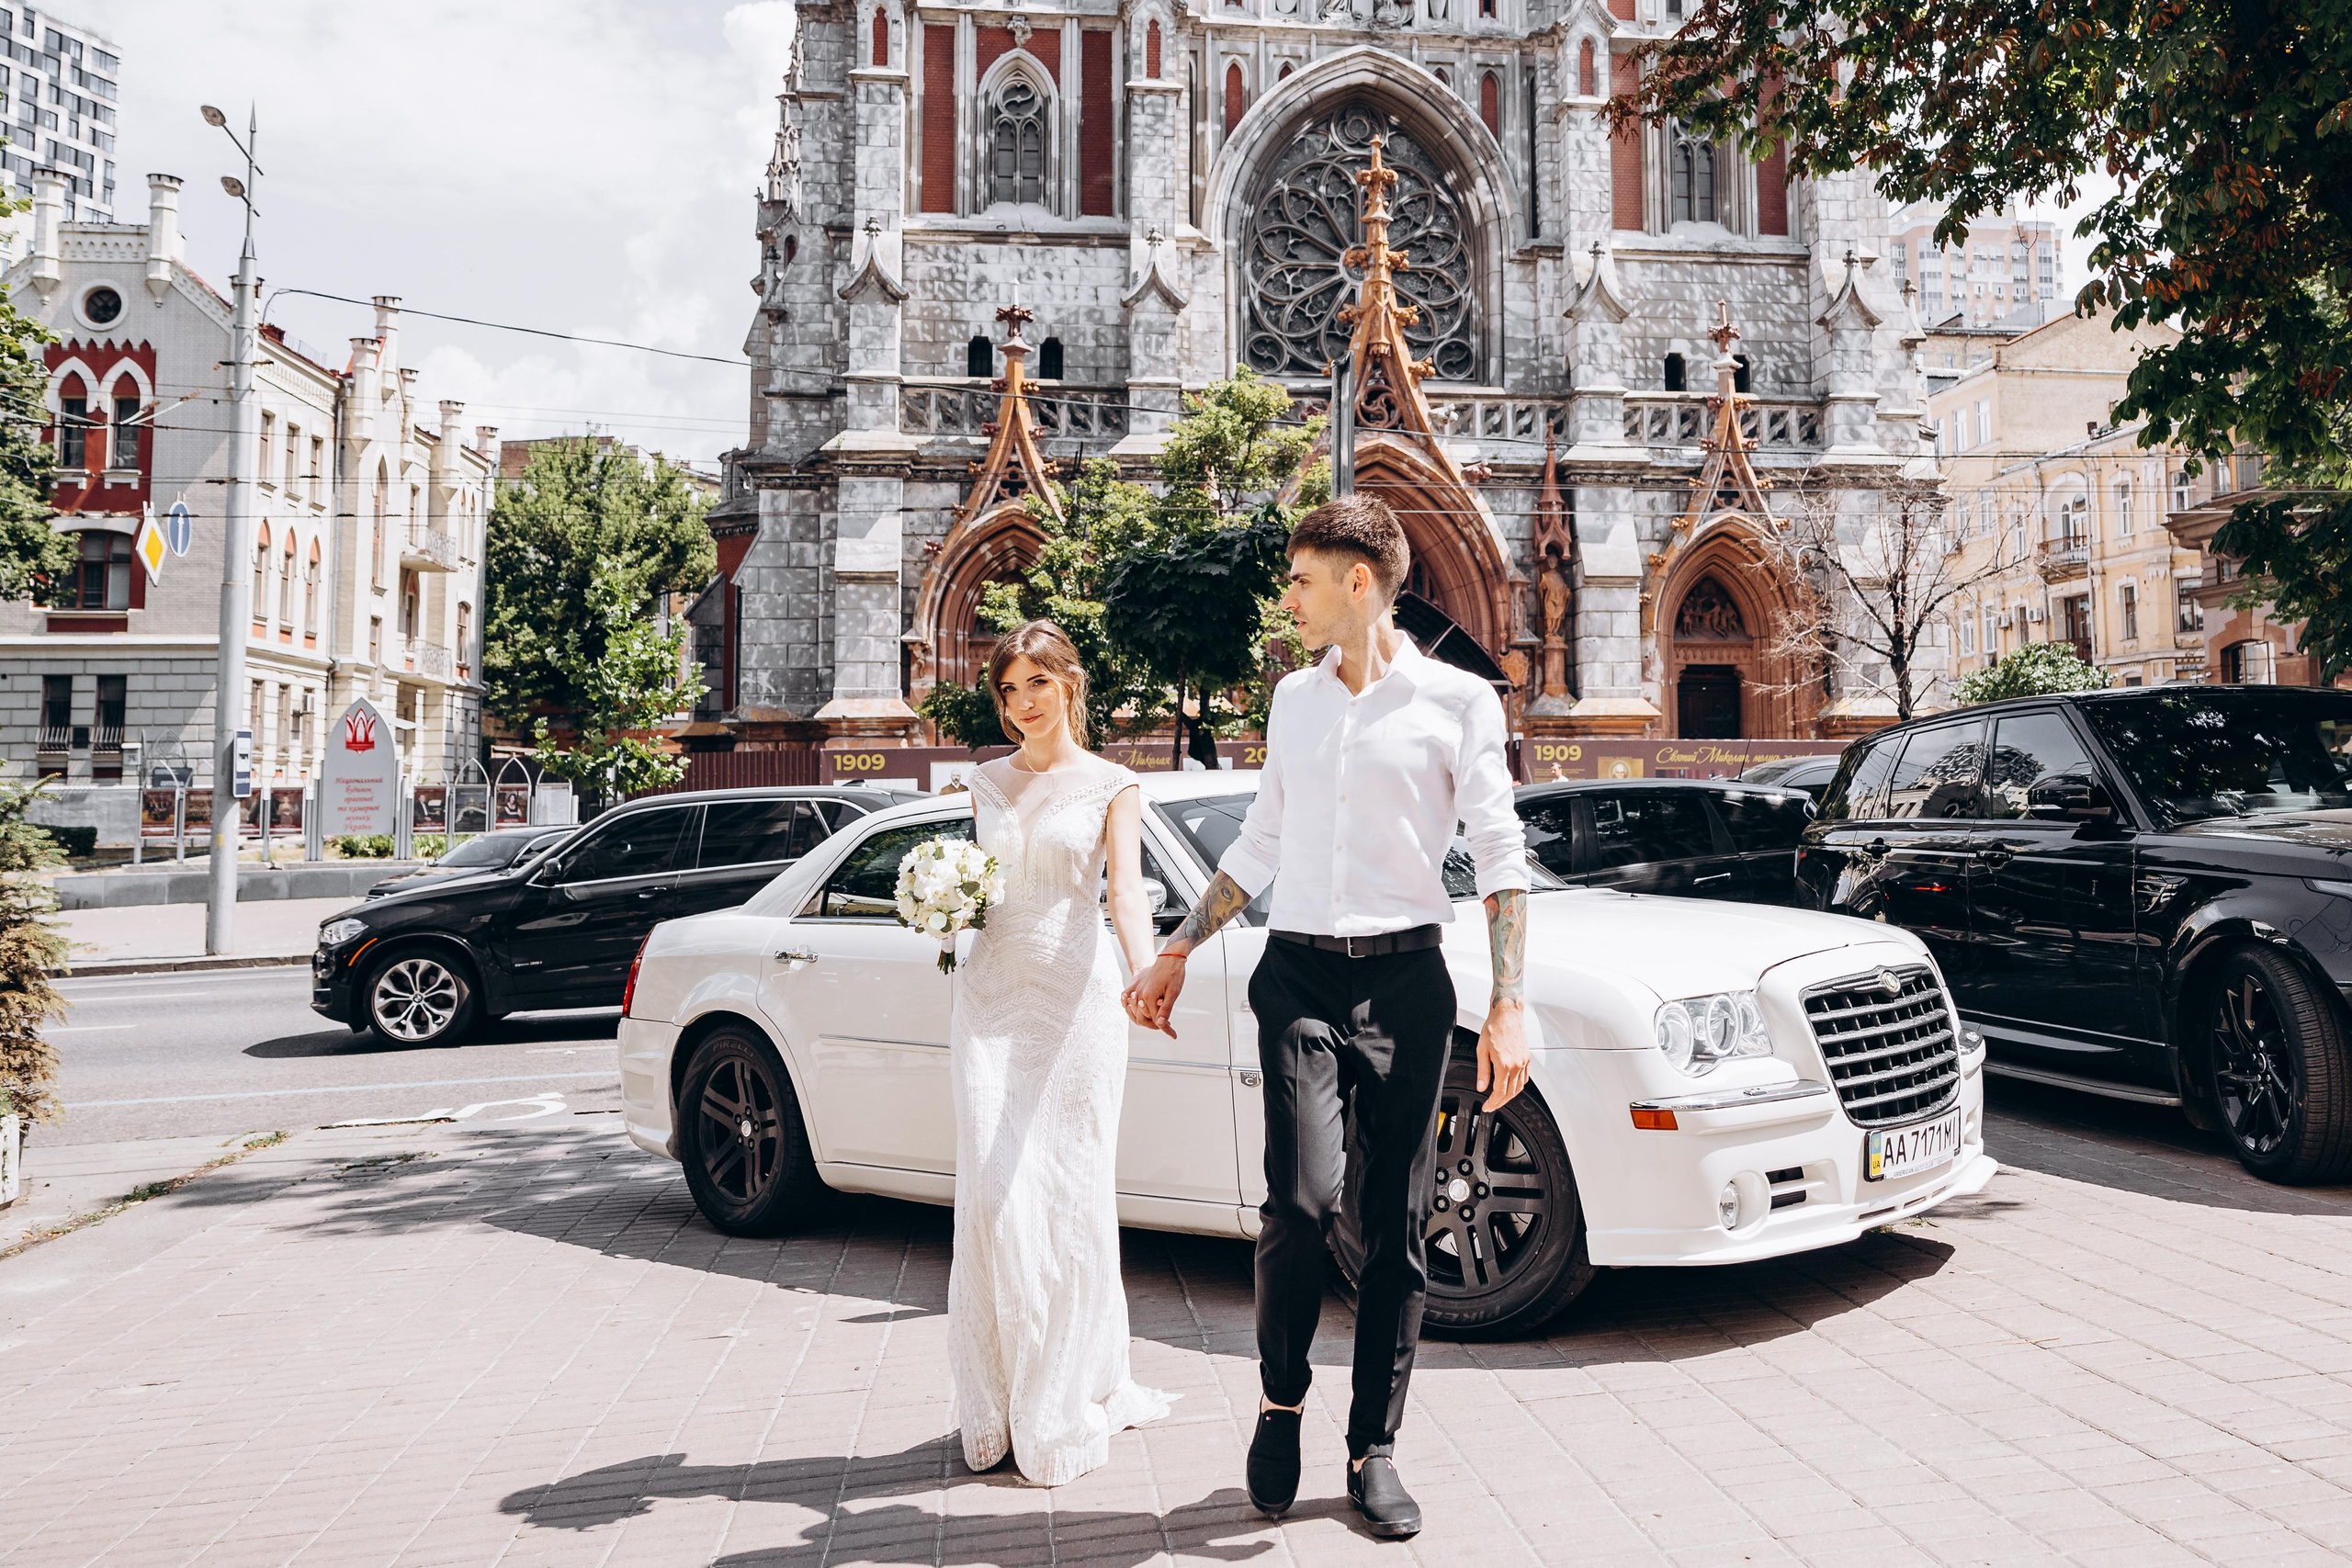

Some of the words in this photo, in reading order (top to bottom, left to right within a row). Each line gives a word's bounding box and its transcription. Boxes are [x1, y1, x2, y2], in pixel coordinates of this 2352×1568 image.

[1118, 749, 1171, 769] Миколая
[1533, 744, 1582, 761] 1909
[1656, 747, 1699, 763] Святий
[832, 753, 886, 772] 1909
[713, 1040, 754, 1057] PIRELLI
[1872, 1160, 1881, 1169] UA
[1894, 1166, 1914, 1177] AMERICAN
